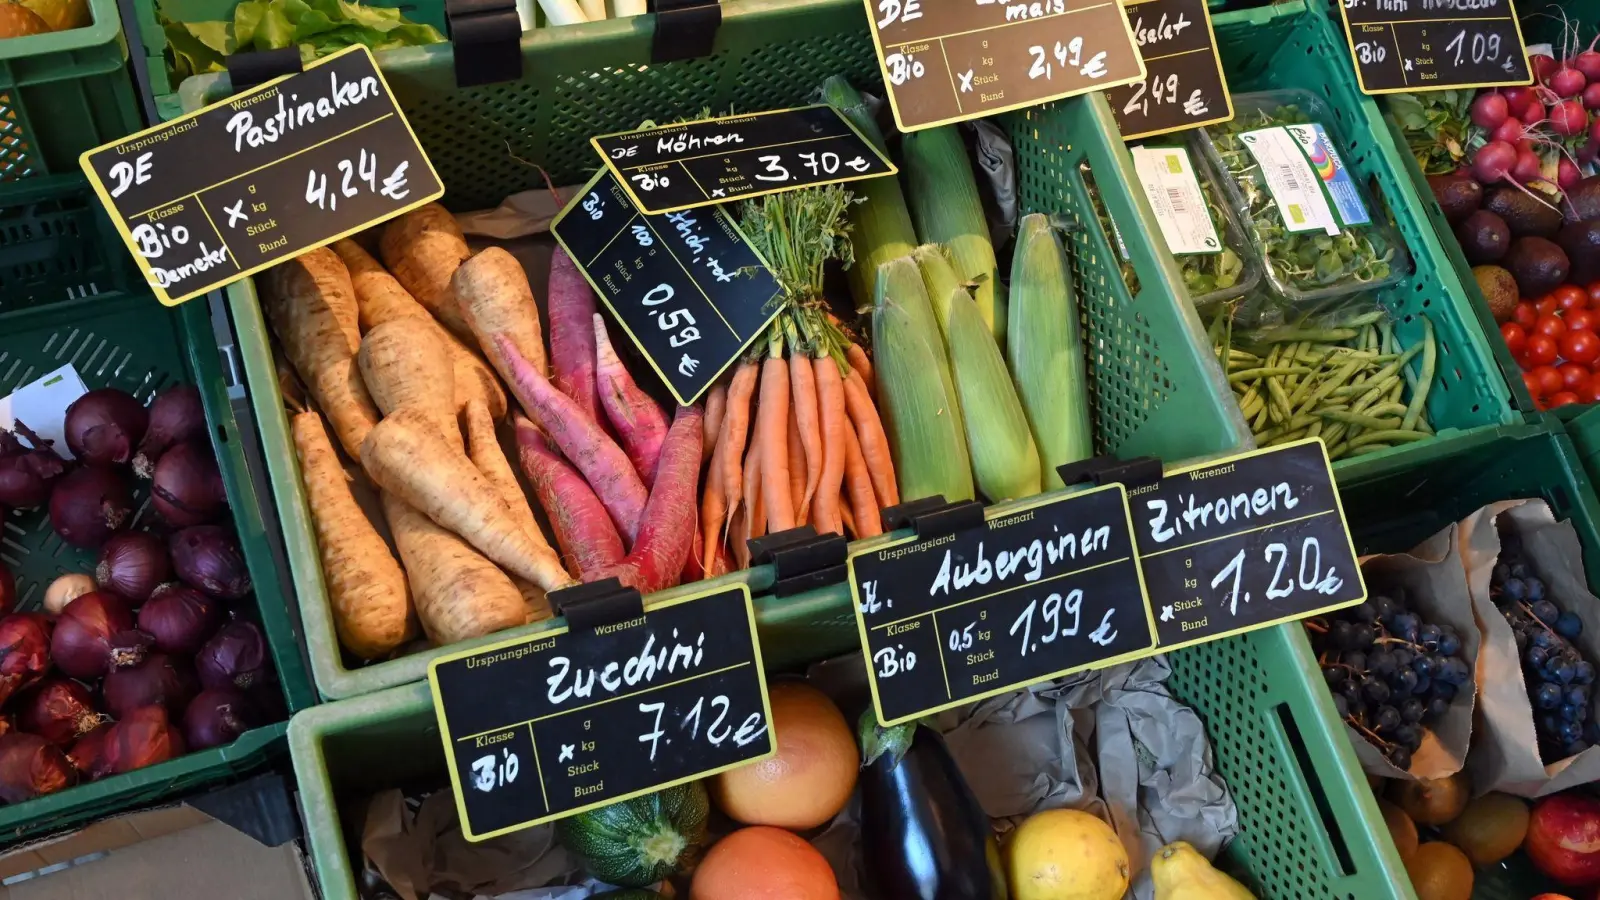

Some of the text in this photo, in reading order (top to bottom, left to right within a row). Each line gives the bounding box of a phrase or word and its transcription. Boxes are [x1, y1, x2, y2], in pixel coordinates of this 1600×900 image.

[877, 0, 924, 30] DE
[1362, 25, 1384, 33] Klasse
[1421, 29, 1427, 37] g
[899, 43, 930, 55] Klasse
[982, 39, 989, 49] g
[1355, 40, 1387, 65] Bio
[1421, 43, 1431, 52] kg
[885, 53, 925, 86] Bio
[982, 56, 994, 67] kg
[1415, 57, 1434, 66] Stück
[973, 74, 1000, 86] Stück
[1420, 72, 1438, 80] Bund
[230, 86, 281, 112] Warenart
[980, 91, 1005, 103] Bund
[226, 71, 379, 152] Pastinaken
[716, 115, 758, 127] Warenart
[116, 118, 199, 155] Ursprungsland
[620, 125, 689, 142] Ursprungsland
[611, 132, 744, 160] DE Möhren
[637, 163, 669, 174] Klasse
[724, 157, 731, 165] g
[725, 165, 738, 174] kg
[109, 152, 154, 198] DE
[632, 173, 670, 191] Bio
[718, 174, 746, 185] Stück
[247, 184, 257, 195] g
[728, 183, 754, 194] Bund
[582, 191, 604, 221] Bio
[609, 186, 630, 210] Klasse
[147, 203, 185, 223] Klasse
[252, 202, 267, 214] kg
[246, 218, 278, 236] Stück
[711, 210, 741, 245] Warenart
[131, 222, 190, 258] Bio
[258, 235, 288, 254] Bund
[631, 224, 657, 257] 100 g
[148, 241, 229, 289] Demeter
[614, 259, 633, 283] Stück
[634, 257, 645, 270] kg
[602, 274, 622, 296] Bund
[1189, 464, 1236, 482] Warenart
[988, 511, 1035, 531] Warenart
[1147, 482, 1299, 543] Zitronen
[879, 533, 956, 562] Ursprungsland
[930, 525, 1111, 596] Auberginen
[1185, 557, 1192, 569] g
[1184, 577, 1198, 589] kg
[1174, 596, 1203, 613] Stück
[980, 609, 987, 620] g
[594, 615, 648, 637] Warenart
[887, 619, 921, 637] Klasse
[1181, 616, 1208, 632] Bund
[949, 621, 991, 652] 0,5 kg
[466, 638, 557, 670] Ursprungsland
[873, 644, 917, 679] Bio
[966, 650, 995, 666] Stück
[546, 627, 705, 704] Zucchini
[972, 669, 1000, 686] Bund
[583, 719, 592, 730] g
[475, 730, 515, 749] Klasse
[581, 739, 596, 753] kg
[469, 748, 519, 793] Bio
[567, 760, 600, 778] Stück
[573, 781, 604, 799] Bund
